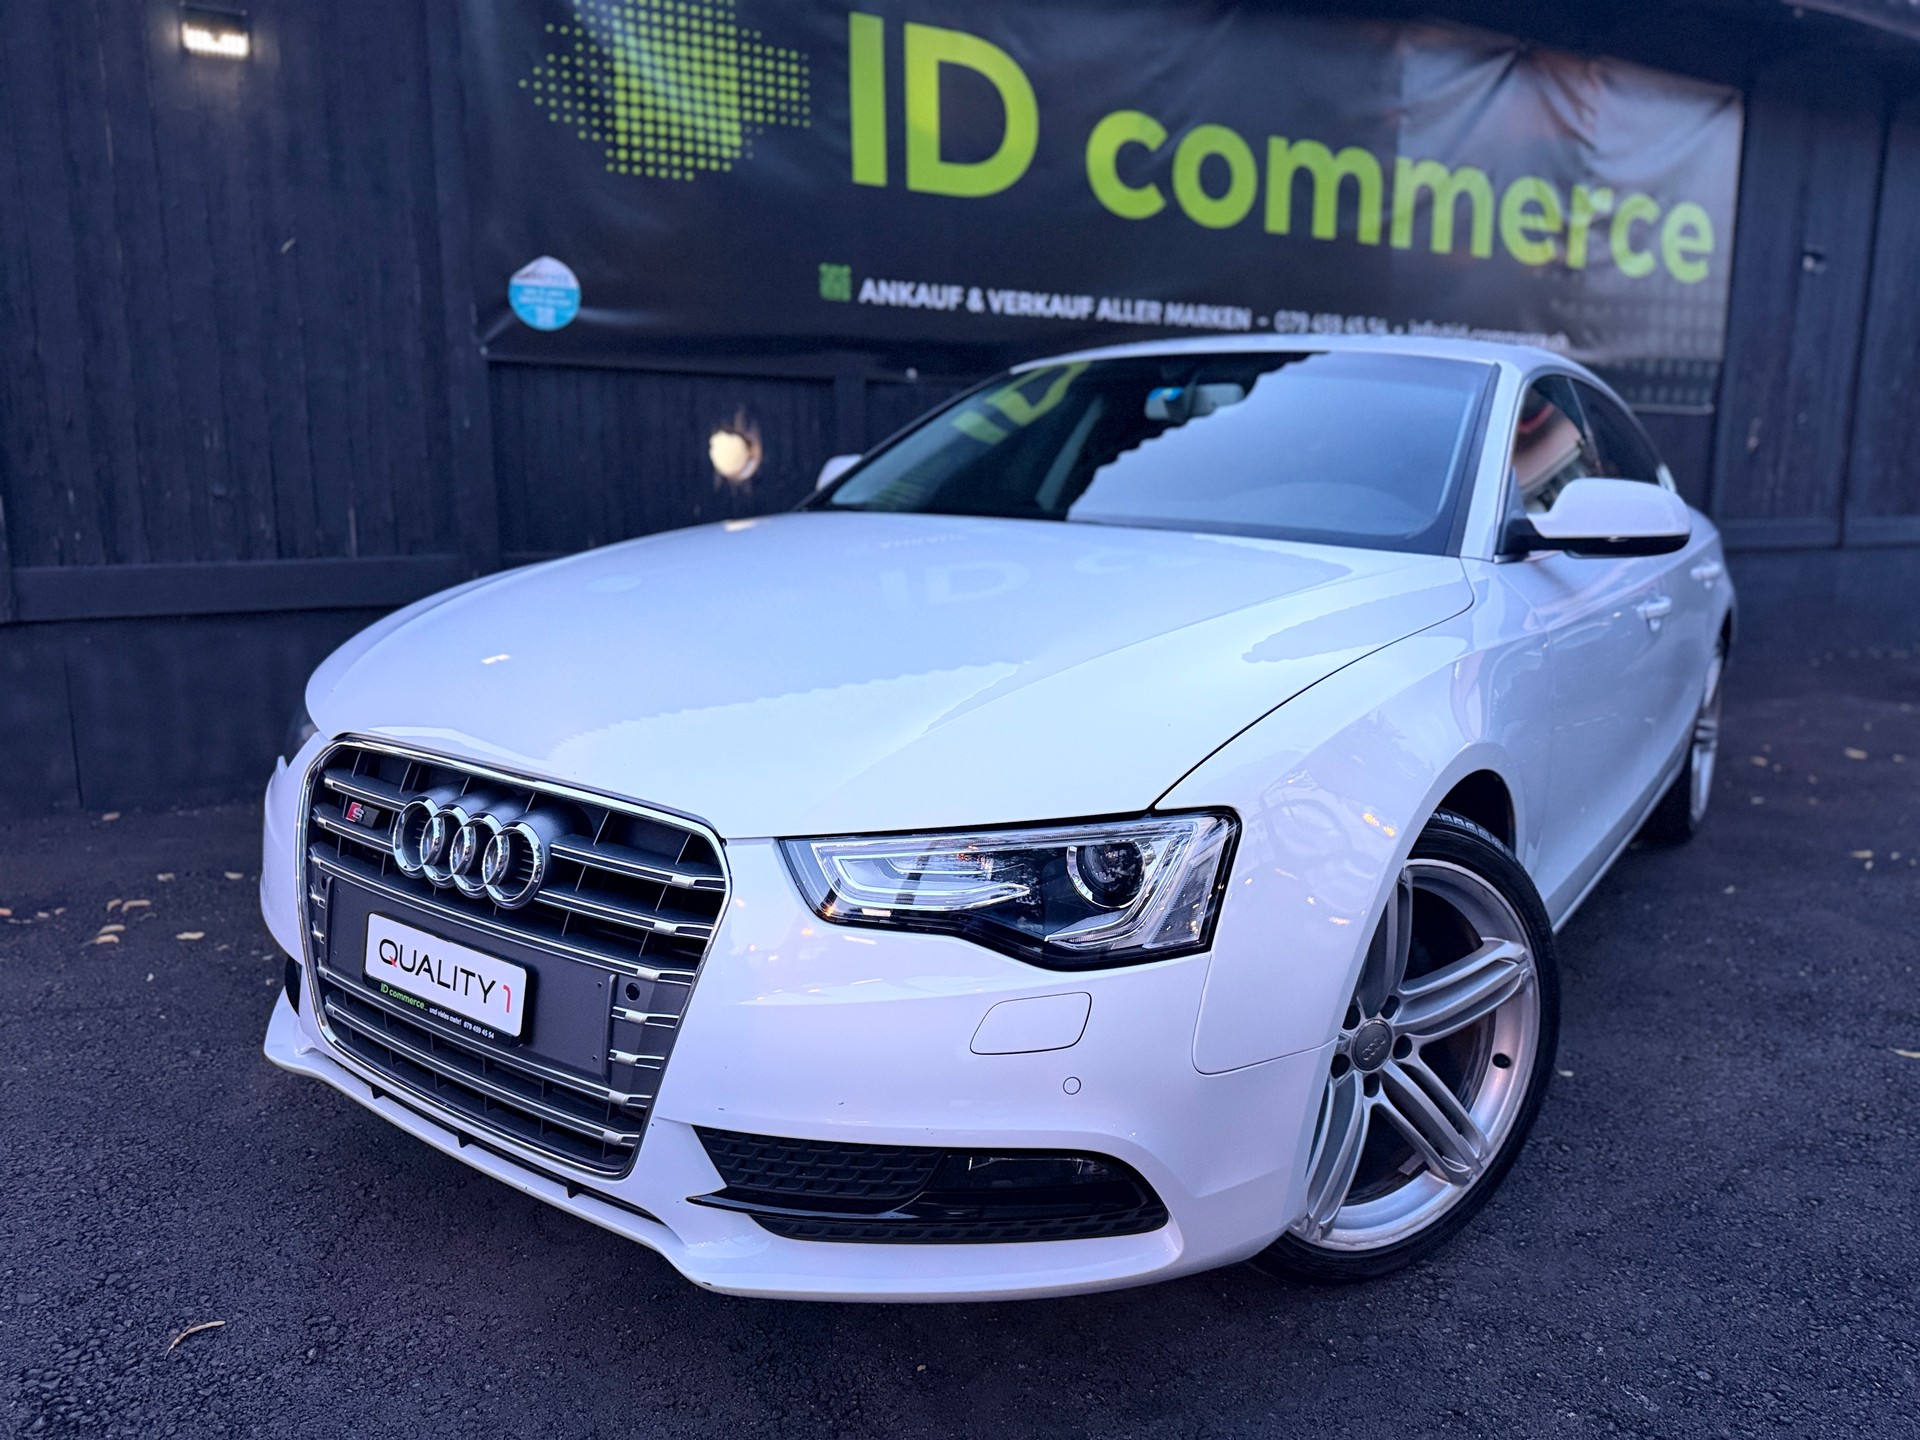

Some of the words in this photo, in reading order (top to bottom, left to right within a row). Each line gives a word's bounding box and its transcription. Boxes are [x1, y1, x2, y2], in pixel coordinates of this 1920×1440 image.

[848, 11, 1040, 199] ID
[1086, 109, 1715, 285] commerce
[857, 277, 965, 311] ANKAUF
[965, 286, 985, 313] &
[986, 287, 1095, 321] VERKAUF
[1095, 297, 1163, 325] ALLER
[1163, 301, 1253, 331] MARKEN
[380, 982, 389, 994] ID
